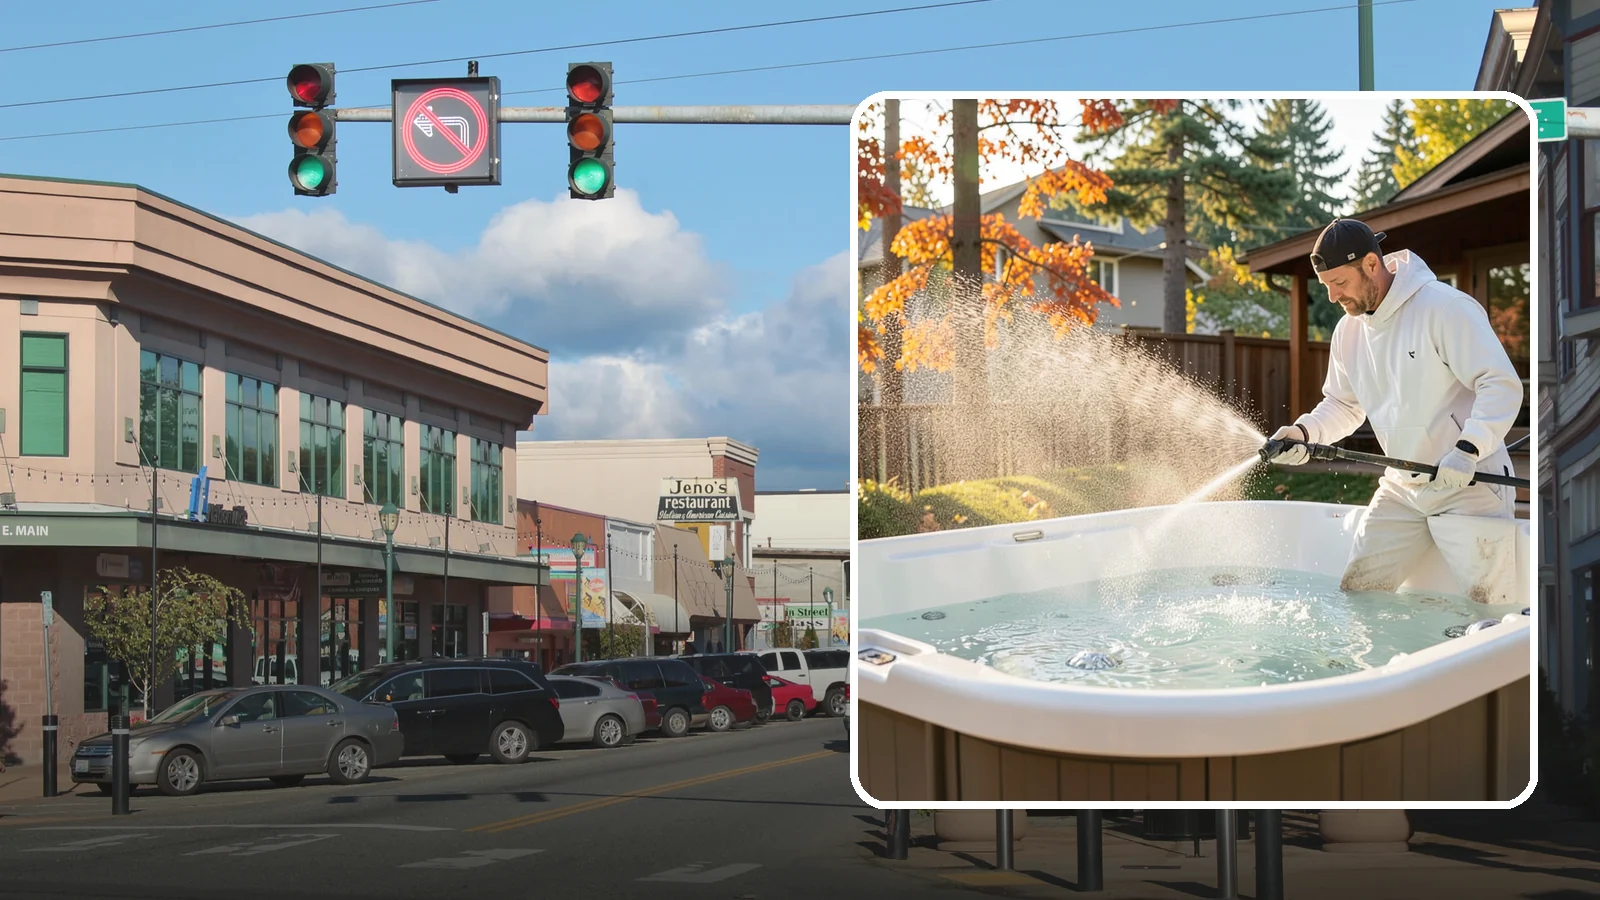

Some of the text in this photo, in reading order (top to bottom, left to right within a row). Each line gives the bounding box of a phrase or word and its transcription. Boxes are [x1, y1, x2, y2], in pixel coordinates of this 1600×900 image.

[670, 480, 727, 494] Jeno's
[665, 496, 731, 509] restaurant
[659, 510, 681, 519] Italian
[686, 510, 714, 519] American
[715, 509, 737, 519] Cuisine
[2, 525, 49, 536] E. MAIN
[797, 607, 828, 616] Street
